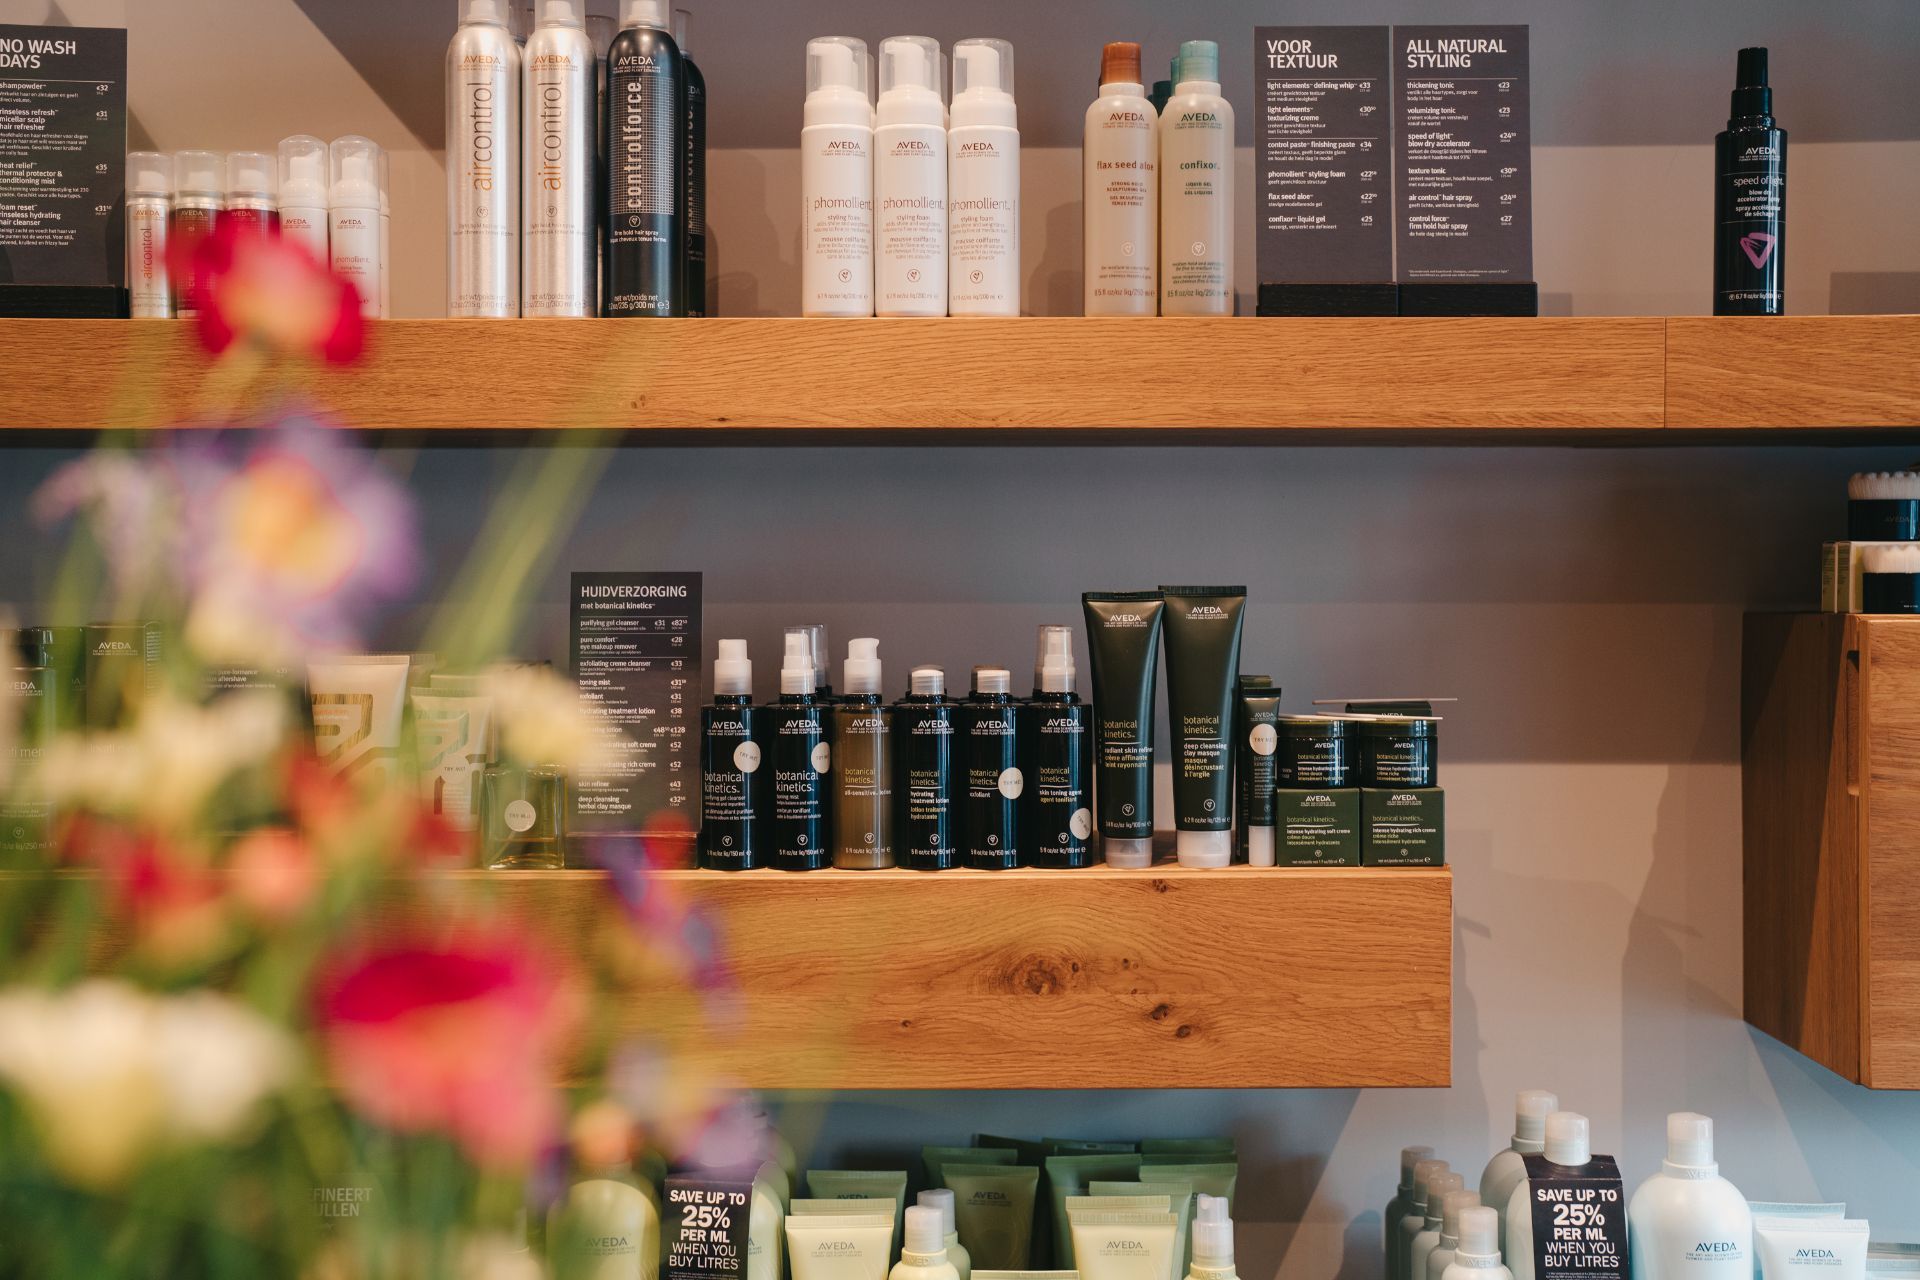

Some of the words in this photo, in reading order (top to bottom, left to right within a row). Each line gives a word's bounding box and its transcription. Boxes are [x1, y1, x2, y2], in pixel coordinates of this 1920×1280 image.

[0, 39, 24, 53] NO
[27, 40, 76, 55] WASH
[1267, 40, 1312, 53] VOOR
[1407, 40, 1434, 53] ALL
[1438, 39, 1507, 53] NATURAL
[0, 54, 41, 69] DAYS
[464, 55, 500, 64] AVEDA
[534, 55, 571, 64] AVEDA
[618, 57, 654, 66] AVEDA
[1267, 55, 1338, 68] TEXTUUR
[1407, 54, 1471, 68] STYLING
[1314, 82, 1338, 90] defining
[1407, 107, 1440, 115] volumizing
[1109, 113, 1145, 121] AVEDA
[1181, 113, 1216, 121] AVEDA
[467, 82, 493, 191] aircontrol
[537, 82, 562, 191] aircontrol
[1408, 133, 1427, 141] speed
[623, 82, 642, 210] controlforce
[828, 141, 861, 149] AVEDA
[896, 141, 929, 149] AVEDA
[961, 143, 993, 151] AVEDA
[1311, 141, 1337, 149] finishing
[1424, 140, 1435, 148] dry
[1097, 161, 1112, 169] flax
[1115, 161, 1137, 169] seed
[1140, 161, 1154, 171] aloe
[1309, 170, 1329, 178] styling
[1733, 176, 1759, 186] speed
[1760, 176, 1768, 185] of
[1455, 194, 1472, 202] spray
[814, 197, 870, 212] phomollient
[883, 197, 942, 212] phomollient
[951, 198, 1008, 212] phomollient
[29, 212, 61, 220] hydrating
[144, 228, 153, 279] aircontrol
[581, 586, 687, 597] HUIDVERZORGING
[99, 642, 131, 650] AVEDA
[580, 660, 609, 668] exfoliating
[852, 719, 884, 727] AVEDA
[1104, 720, 1137, 729] botanical
[1184, 716, 1219, 724] botanical
[1184, 743, 1199, 751] deep
[1184, 757, 1207, 765] masque
[1040, 767, 1070, 775] botanical
[1184, 763, 1224, 771] désincrustant
[704, 772, 745, 782] botanical
[776, 770, 819, 781] botanical
[970, 769, 998, 777] botanical
[845, 776, 871, 784] kinetics
[704, 783, 737, 793] kinetics
[776, 782, 812, 792] kinetics
[670, 1189, 703, 1203] SAVE
[706, 1192, 725, 1204] UP
[729, 1193, 745, 1205] TO
[1537, 1189, 1572, 1202] SAVE
[1576, 1189, 1595, 1201] UP
[1599, 1189, 1617, 1202] TO
[681, 1205, 730, 1228] 25%
[1553, 1204, 1605, 1226] 25%
[680, 1229, 706, 1241] PER
[710, 1230, 730, 1243] ML
[1554, 1228, 1581, 1240] PER
[1586, 1228, 1607, 1240] ML
[672, 1242, 708, 1255] WHEN
[712, 1244, 736, 1256] YOU
[819, 1241, 855, 1250] AVEDA
[1107, 1240, 1143, 1249] AVEDA
[1546, 1242, 1585, 1254] WHEN
[1589, 1242, 1615, 1254] YOU
[1695, 1242, 1736, 1252] AVEDA
[1796, 1249, 1834, 1258] AVEDA
[669, 1255, 693, 1267] BUY
[1545, 1255, 1570, 1267] BUY
